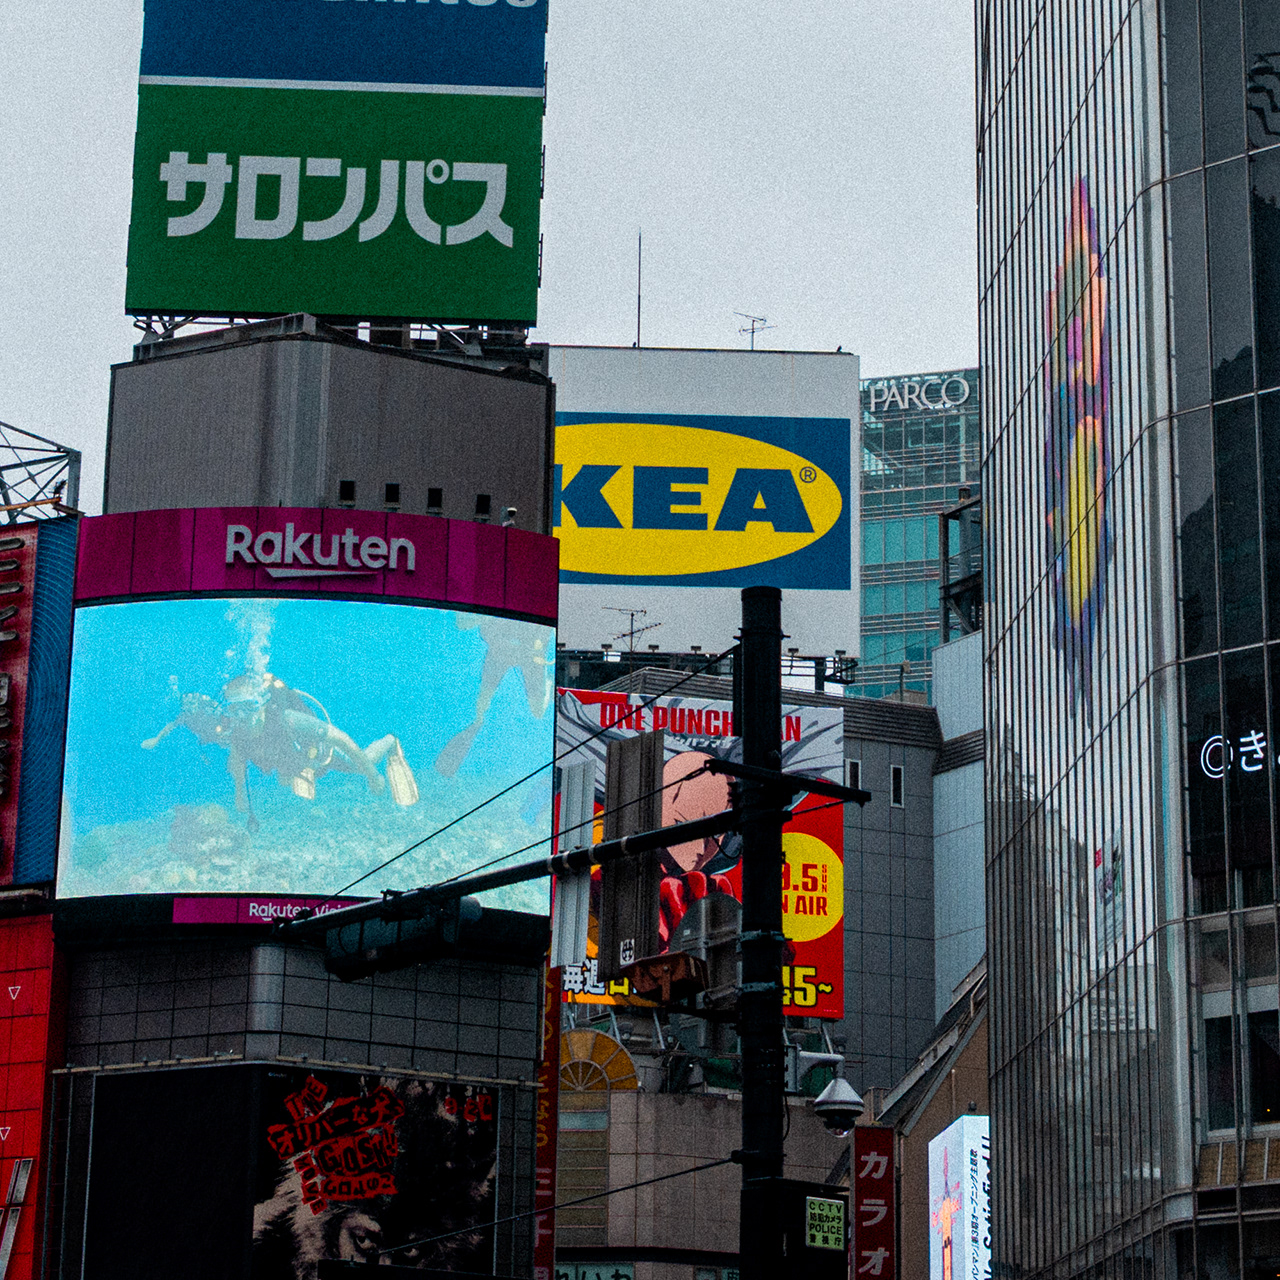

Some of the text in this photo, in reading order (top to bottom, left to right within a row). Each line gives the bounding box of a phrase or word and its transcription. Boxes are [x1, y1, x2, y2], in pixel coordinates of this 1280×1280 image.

[159, 150, 515, 249] サロンパス
[869, 376, 970, 412] PARCO
[553, 463, 815, 534] KEA
[224, 521, 418, 571] Rakuten
[600, 701, 646, 732] ONE
[652, 706, 734, 737] PUNCH
[793, 895, 829, 917] AIR
[809, 1200, 843, 1214] CCTV
[858, 1150, 890, 1276] カラオ
[809, 1222, 843, 1236] POLICE
